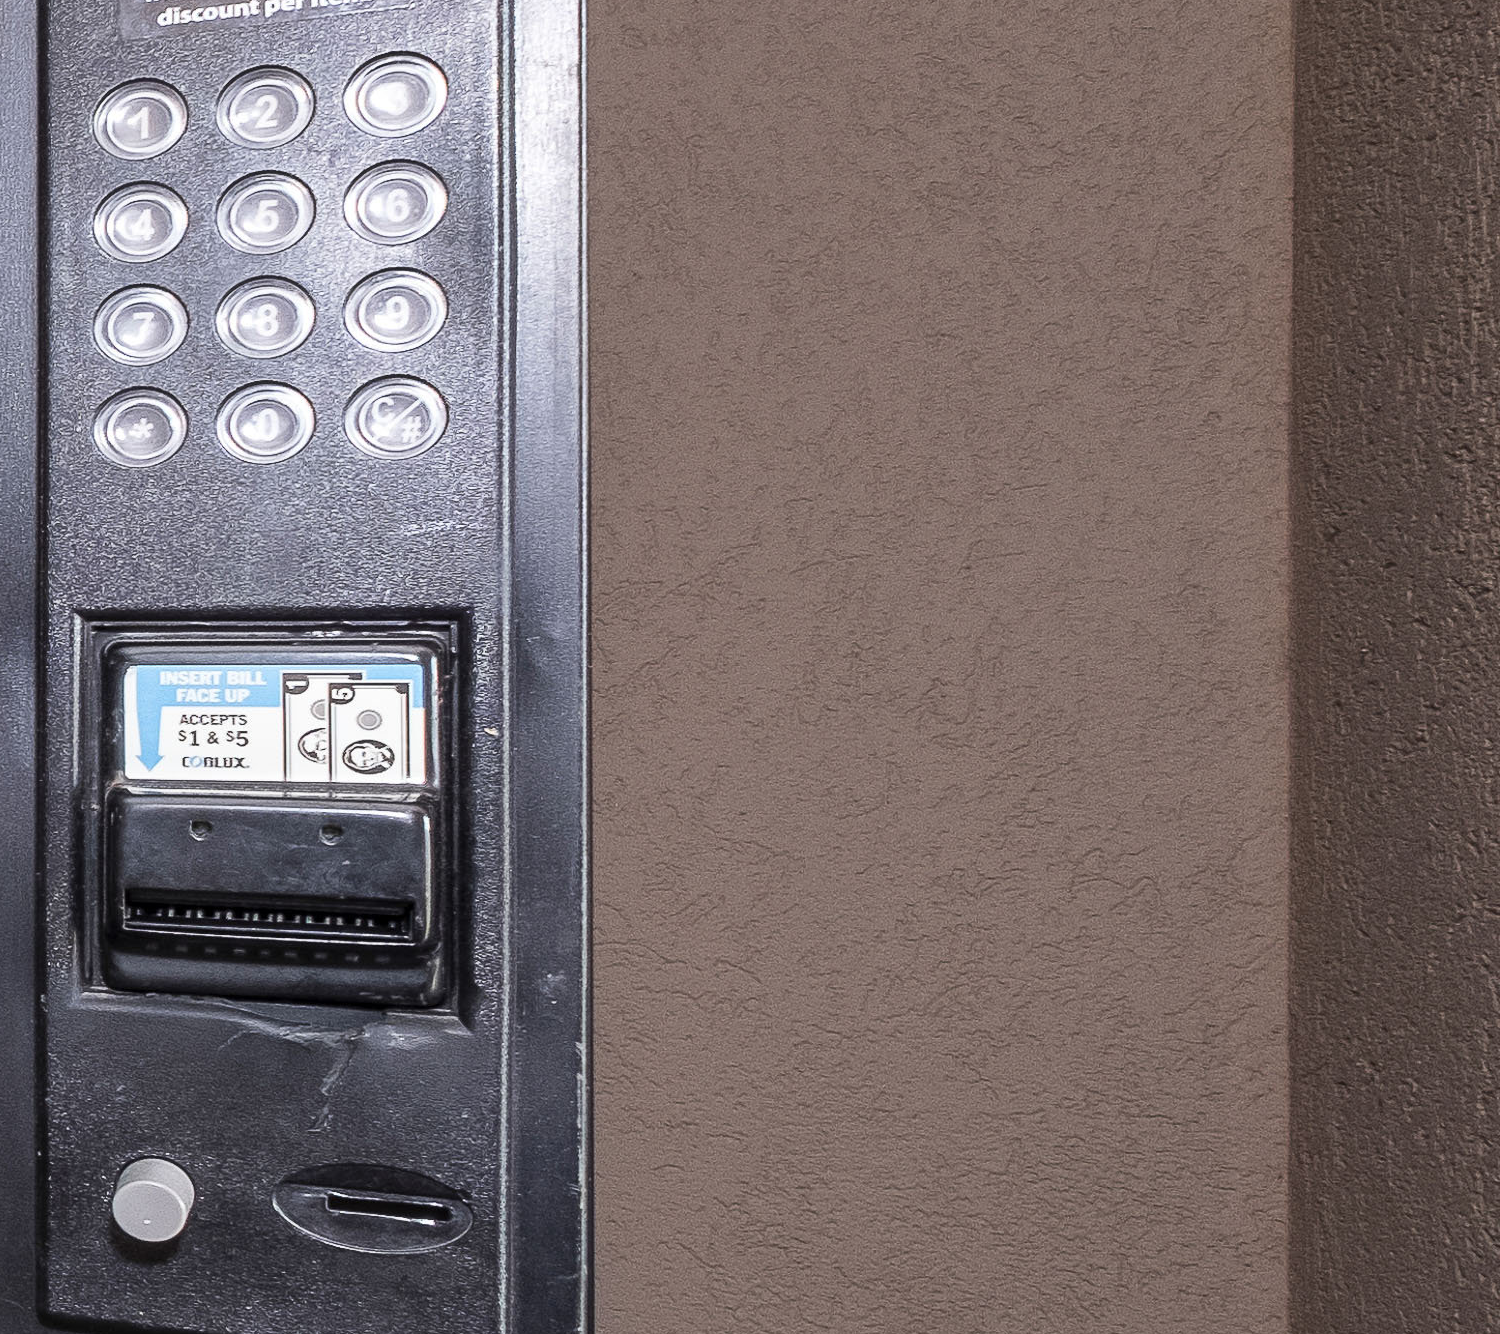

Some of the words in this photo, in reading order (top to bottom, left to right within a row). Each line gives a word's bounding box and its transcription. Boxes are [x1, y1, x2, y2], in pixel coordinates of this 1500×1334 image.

[156, 2, 261, 27] discount
[253, 95, 279, 128] 2
[159, 670, 223, 686] INSERT
[226, 671, 267, 686] BILL
[176, 688, 221, 702] FACE
[225, 688, 250, 703] UP
[179, 714, 248, 726] ACCEPTS
[178, 730, 200, 747] $1
[207, 731, 220, 745] &
[226, 730, 249, 747] $5
